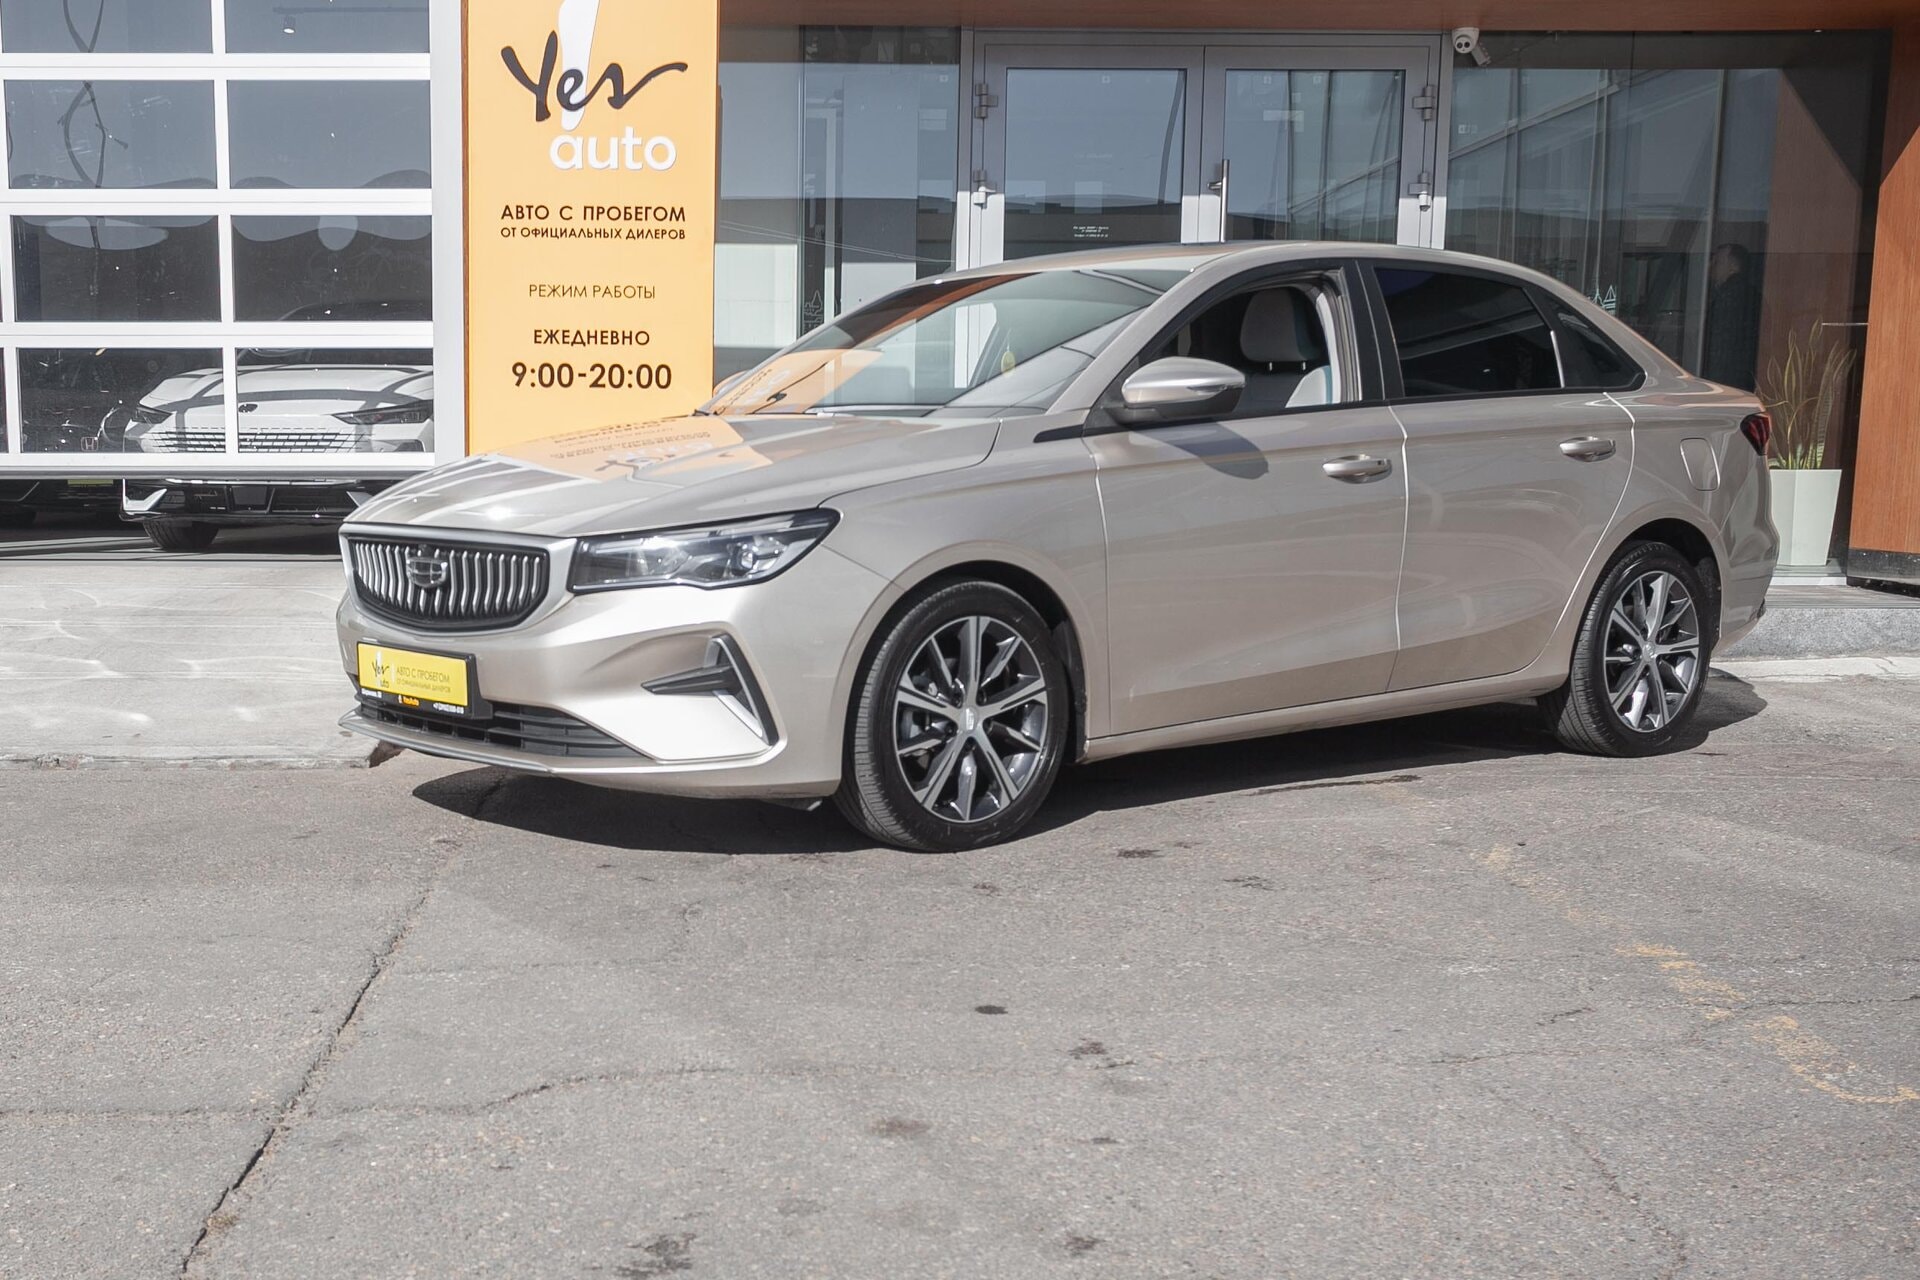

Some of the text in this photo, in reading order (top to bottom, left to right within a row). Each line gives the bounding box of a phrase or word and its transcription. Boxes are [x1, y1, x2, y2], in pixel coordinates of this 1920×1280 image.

[500, 30, 689, 121] Yes
[549, 127, 677, 171] auto
[501, 205, 686, 222] АВТО С ПРОБЕГОМ
[500, 227, 686, 240] ОТ ОФИЦИАЛЬНЫХ ДИЛЕРОВ
[529, 284, 656, 300] РЕЖИМ РАБОТЫ
[533, 329, 650, 347] ЕЖЕДНЕВНО
[511, 362, 672, 389] 9:00-20:00
[396, 666, 411, 677] АВТО
[417, 669, 450, 683] ПРОБЕГОМ
